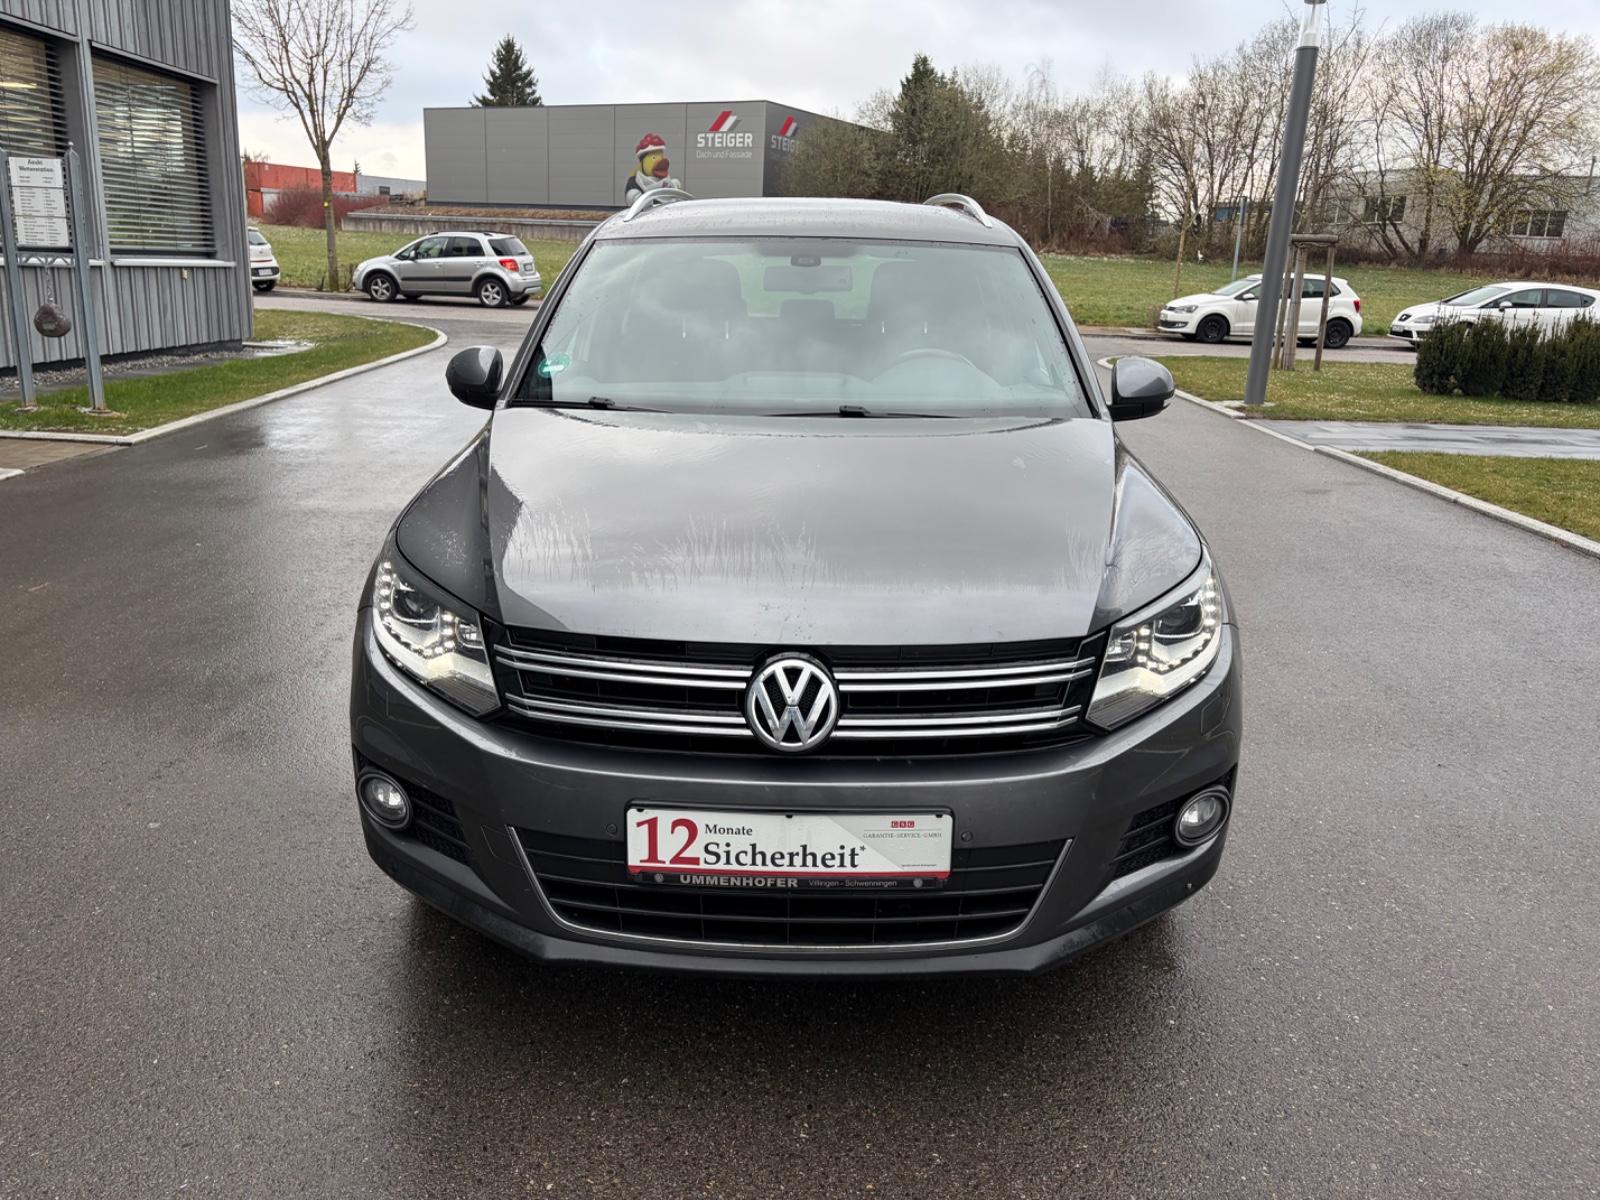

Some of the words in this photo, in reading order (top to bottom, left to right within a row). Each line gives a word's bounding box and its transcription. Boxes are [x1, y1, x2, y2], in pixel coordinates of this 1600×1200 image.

[697, 133, 753, 148] STEIGER
[771, 135, 796, 153] STEIG
[696, 150, 712, 159] Dach
[713, 150, 724, 159] und
[724, 150, 752, 159] Fassade
[705, 823, 753, 836] Monate
[636, 816, 701, 866] 12
[679, 874, 798, 888] UMMENHOFER
[845, 879, 898, 888] Schwenningen
